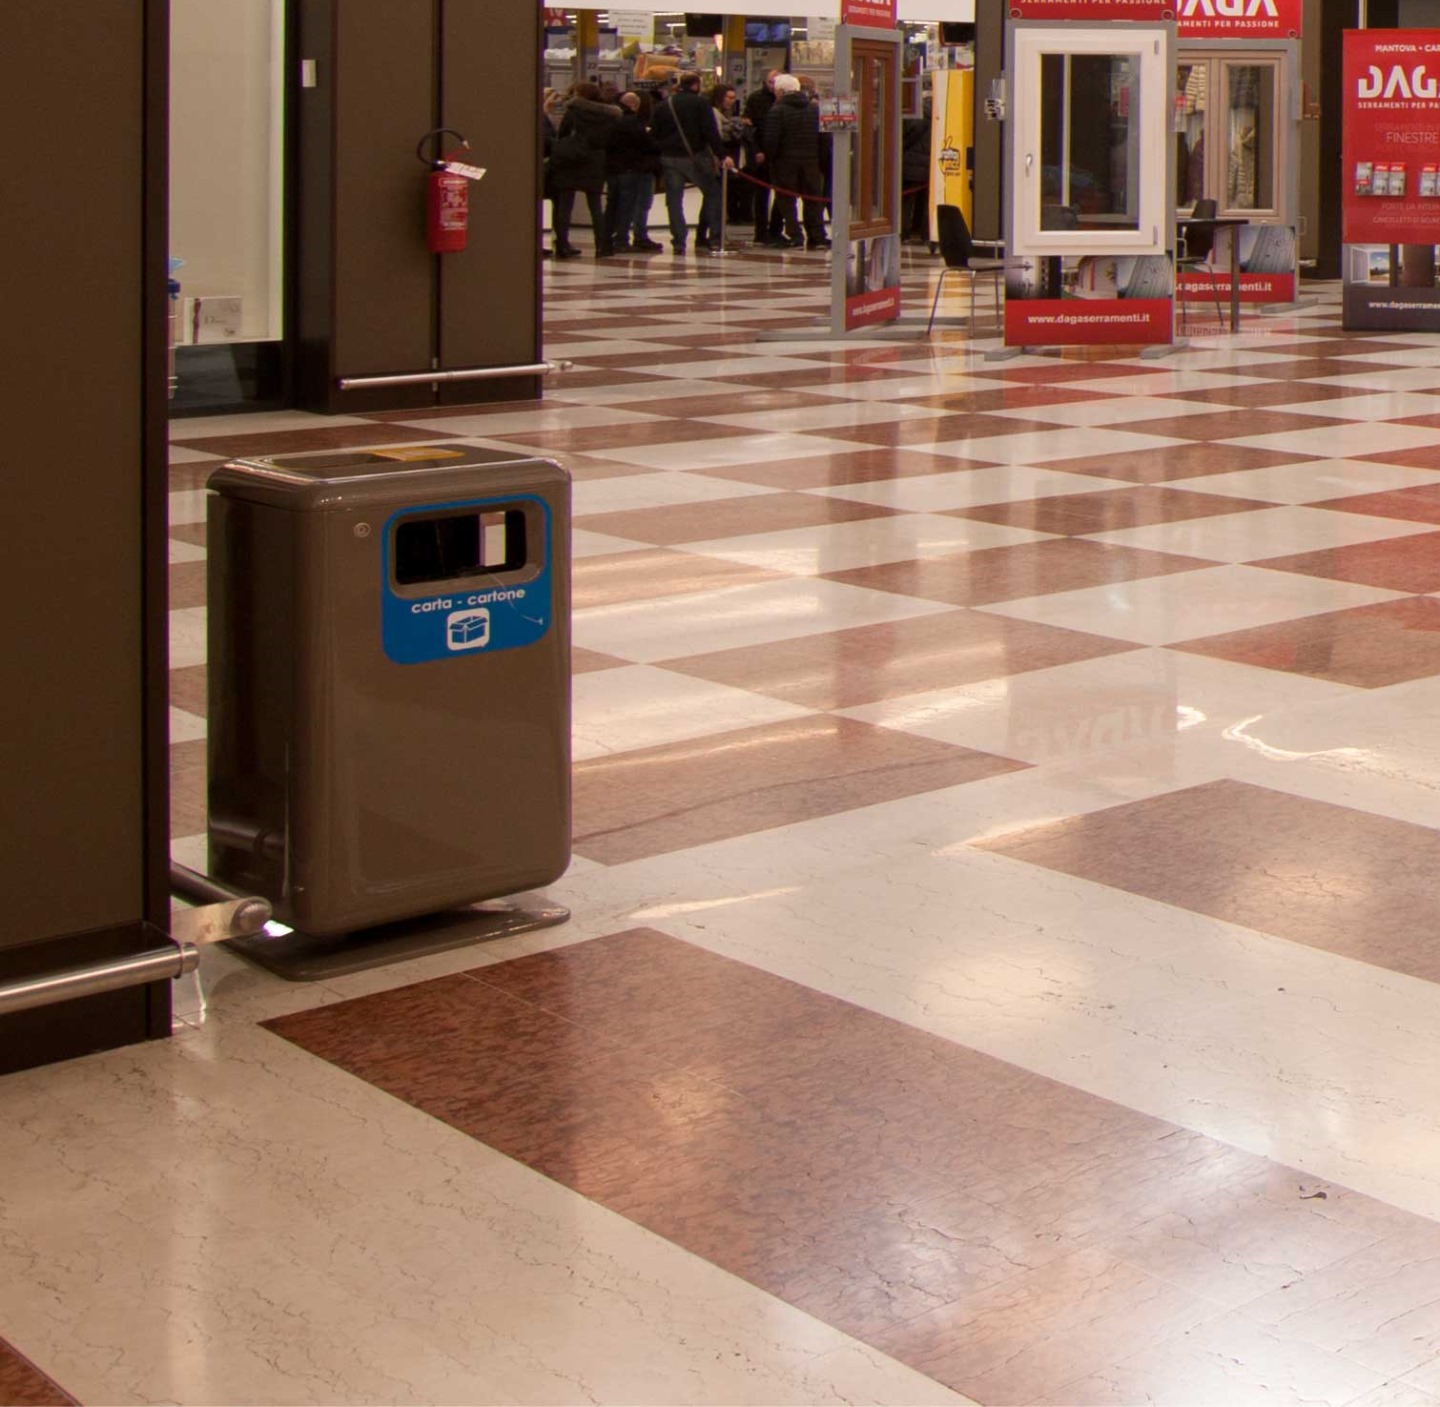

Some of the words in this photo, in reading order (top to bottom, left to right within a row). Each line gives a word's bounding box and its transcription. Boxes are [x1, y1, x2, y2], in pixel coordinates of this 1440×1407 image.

[1214, 20, 1231, 28] PER
[1234, 20, 1279, 28] PASSIONE
[1375, 44, 1417, 53] MANTOVA
[1358, 101, 1409, 110] SERRAMENTI
[1411, 101, 1427, 110] PER
[1385, 131, 1440, 144] FINESTRE
[411, 599, 453, 614] carta
[467, 588, 527, 606] cartone
